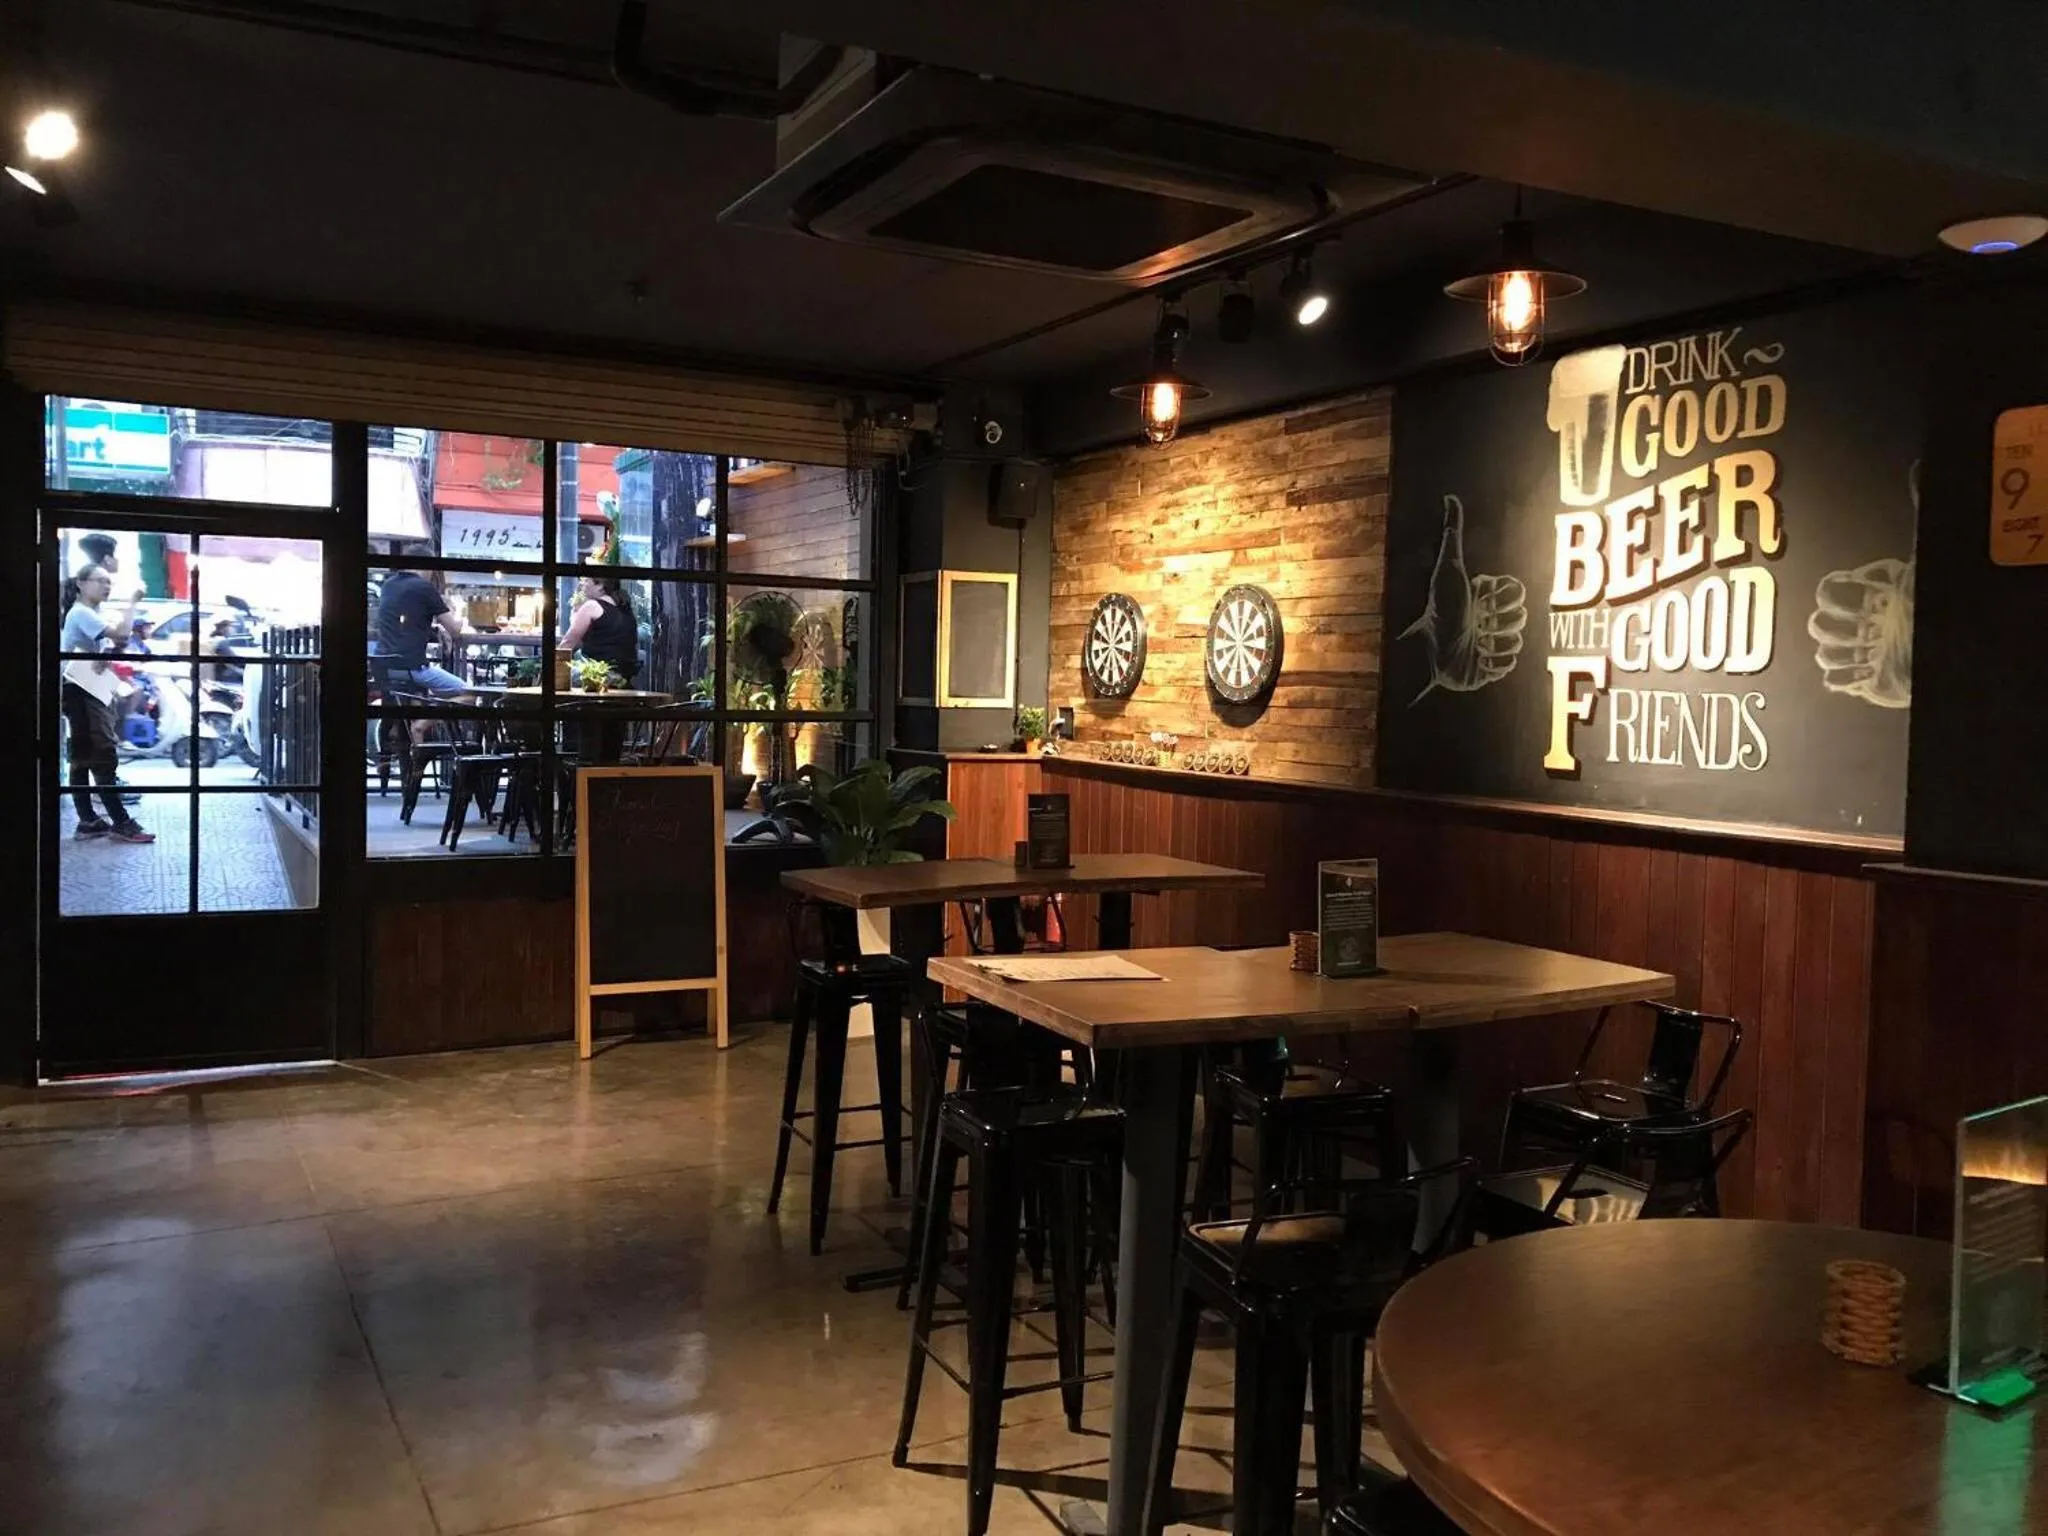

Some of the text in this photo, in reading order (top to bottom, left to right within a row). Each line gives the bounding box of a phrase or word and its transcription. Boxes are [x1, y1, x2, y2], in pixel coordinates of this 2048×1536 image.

[1624, 327, 1743, 394] DRINK
[66, 437, 105, 460] art
[1620, 374, 1787, 478] GOOD
[1549, 449, 1785, 609] BEER
[1549, 566, 1775, 673] WITH GOOD
[1543, 655, 1768, 775] FRIENDS
